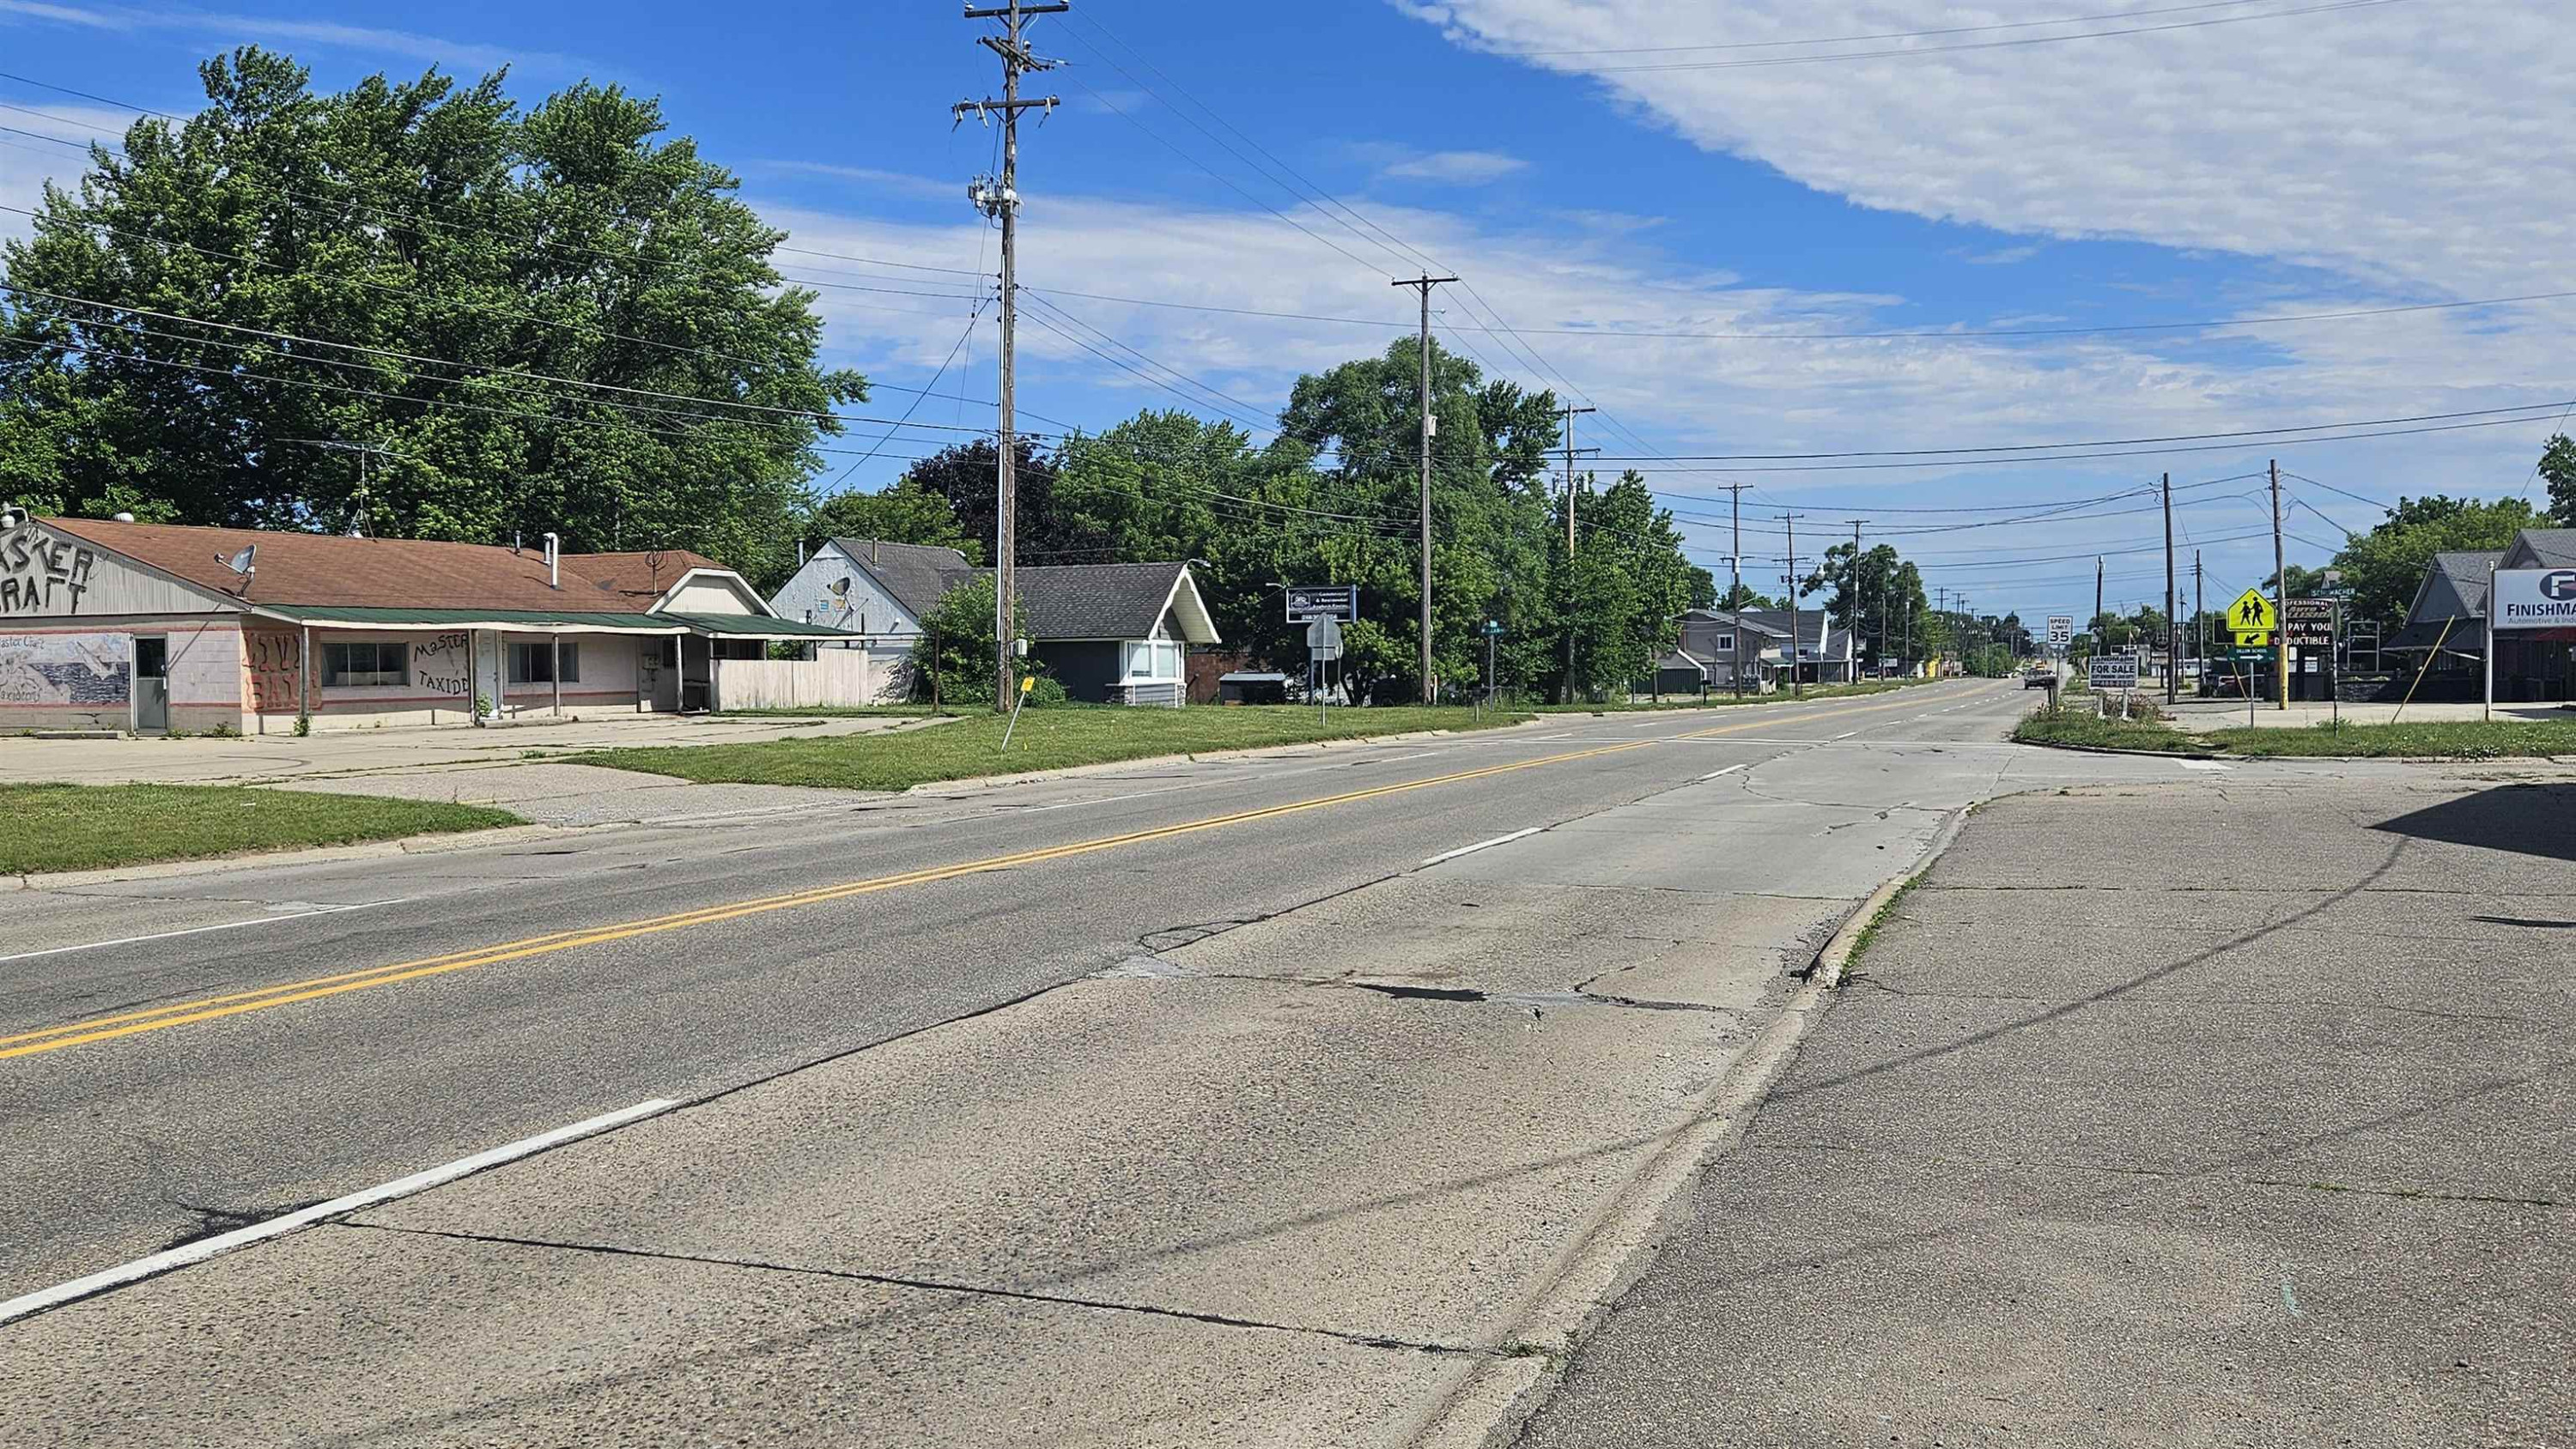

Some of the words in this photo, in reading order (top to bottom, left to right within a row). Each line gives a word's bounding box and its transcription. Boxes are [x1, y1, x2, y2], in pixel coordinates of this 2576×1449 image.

[0, 574, 87, 614] RAFT
[2287, 622, 2306, 631] PAY
[2050, 631, 2069, 642] 35
[2274, 636, 2330, 646] DDUCTIBLE
